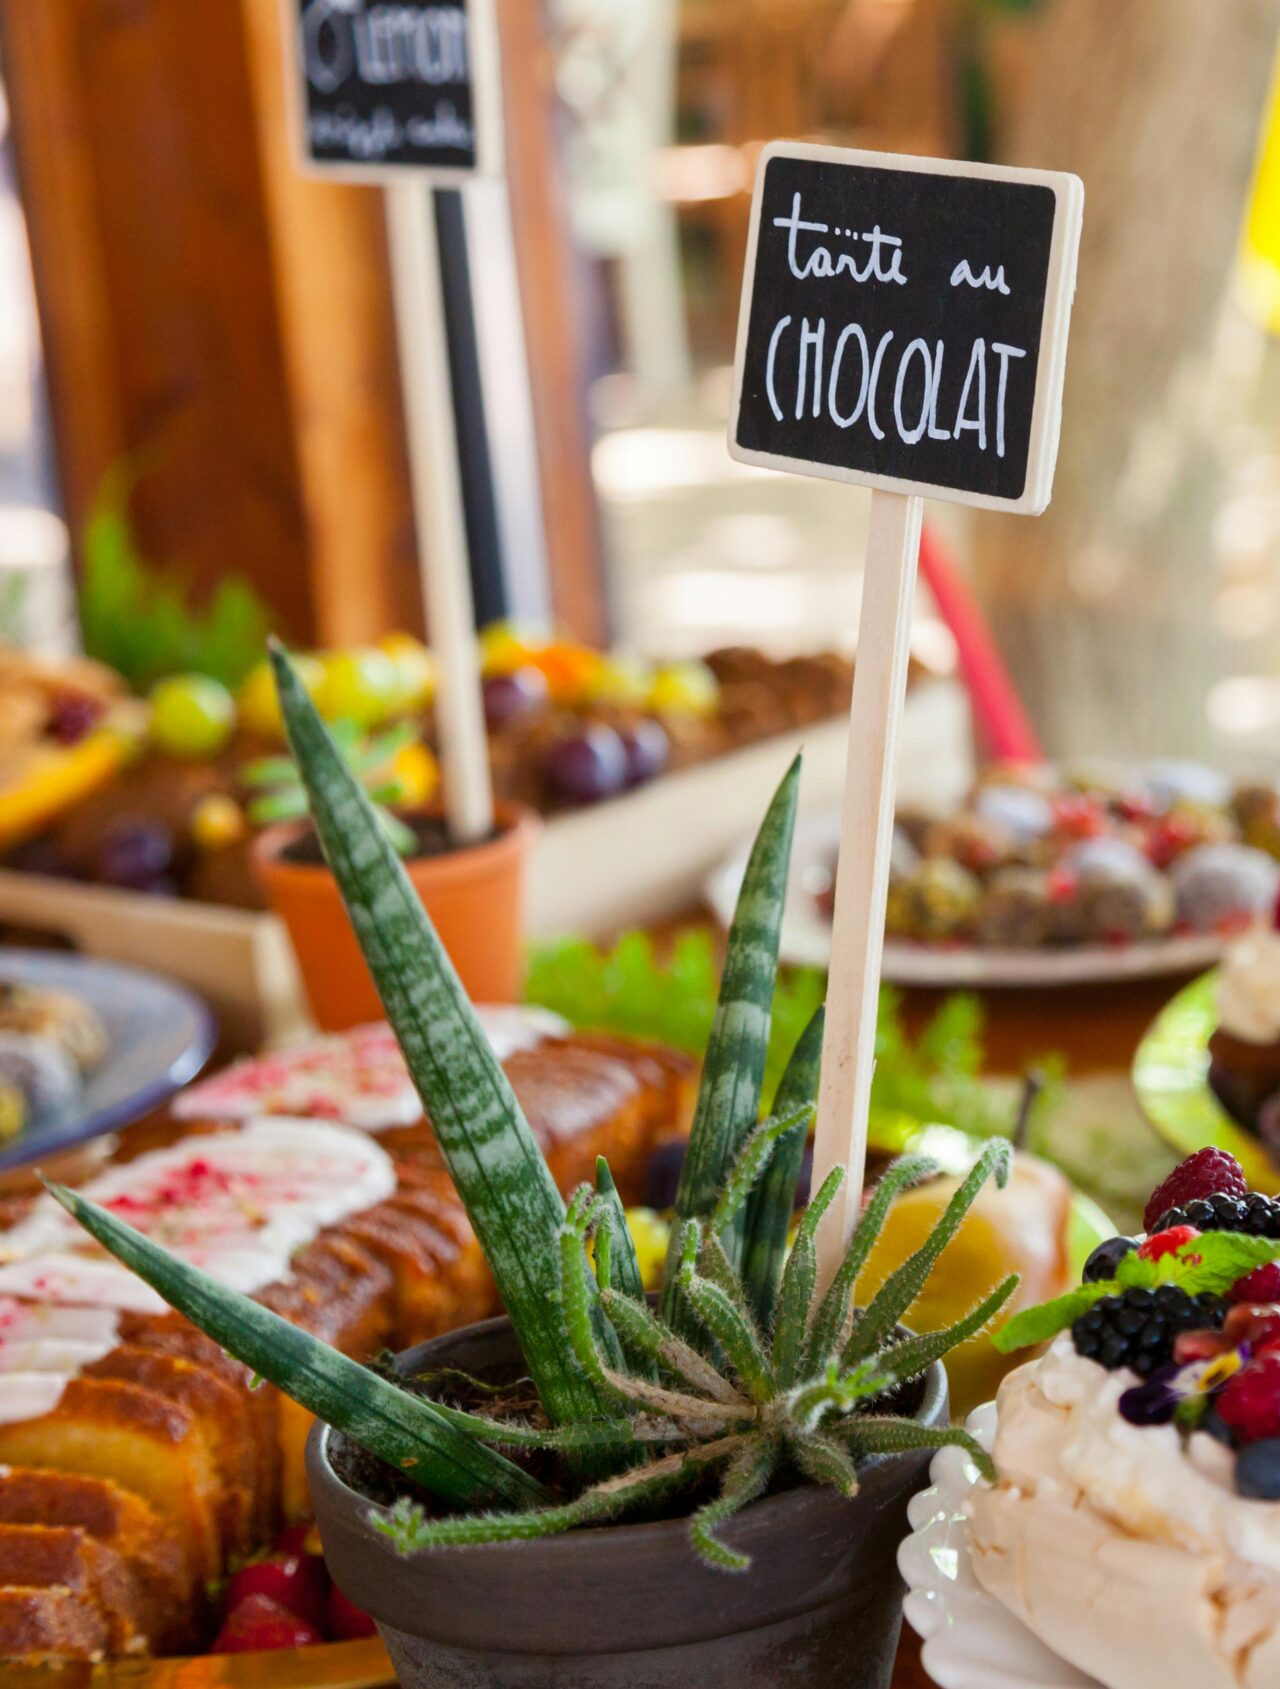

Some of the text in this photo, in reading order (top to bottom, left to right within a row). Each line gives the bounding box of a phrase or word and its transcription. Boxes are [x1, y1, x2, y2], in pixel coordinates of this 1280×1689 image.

[772, 191, 1011, 295] tarte au
[765, 314, 1027, 458] CHOCOLAT
